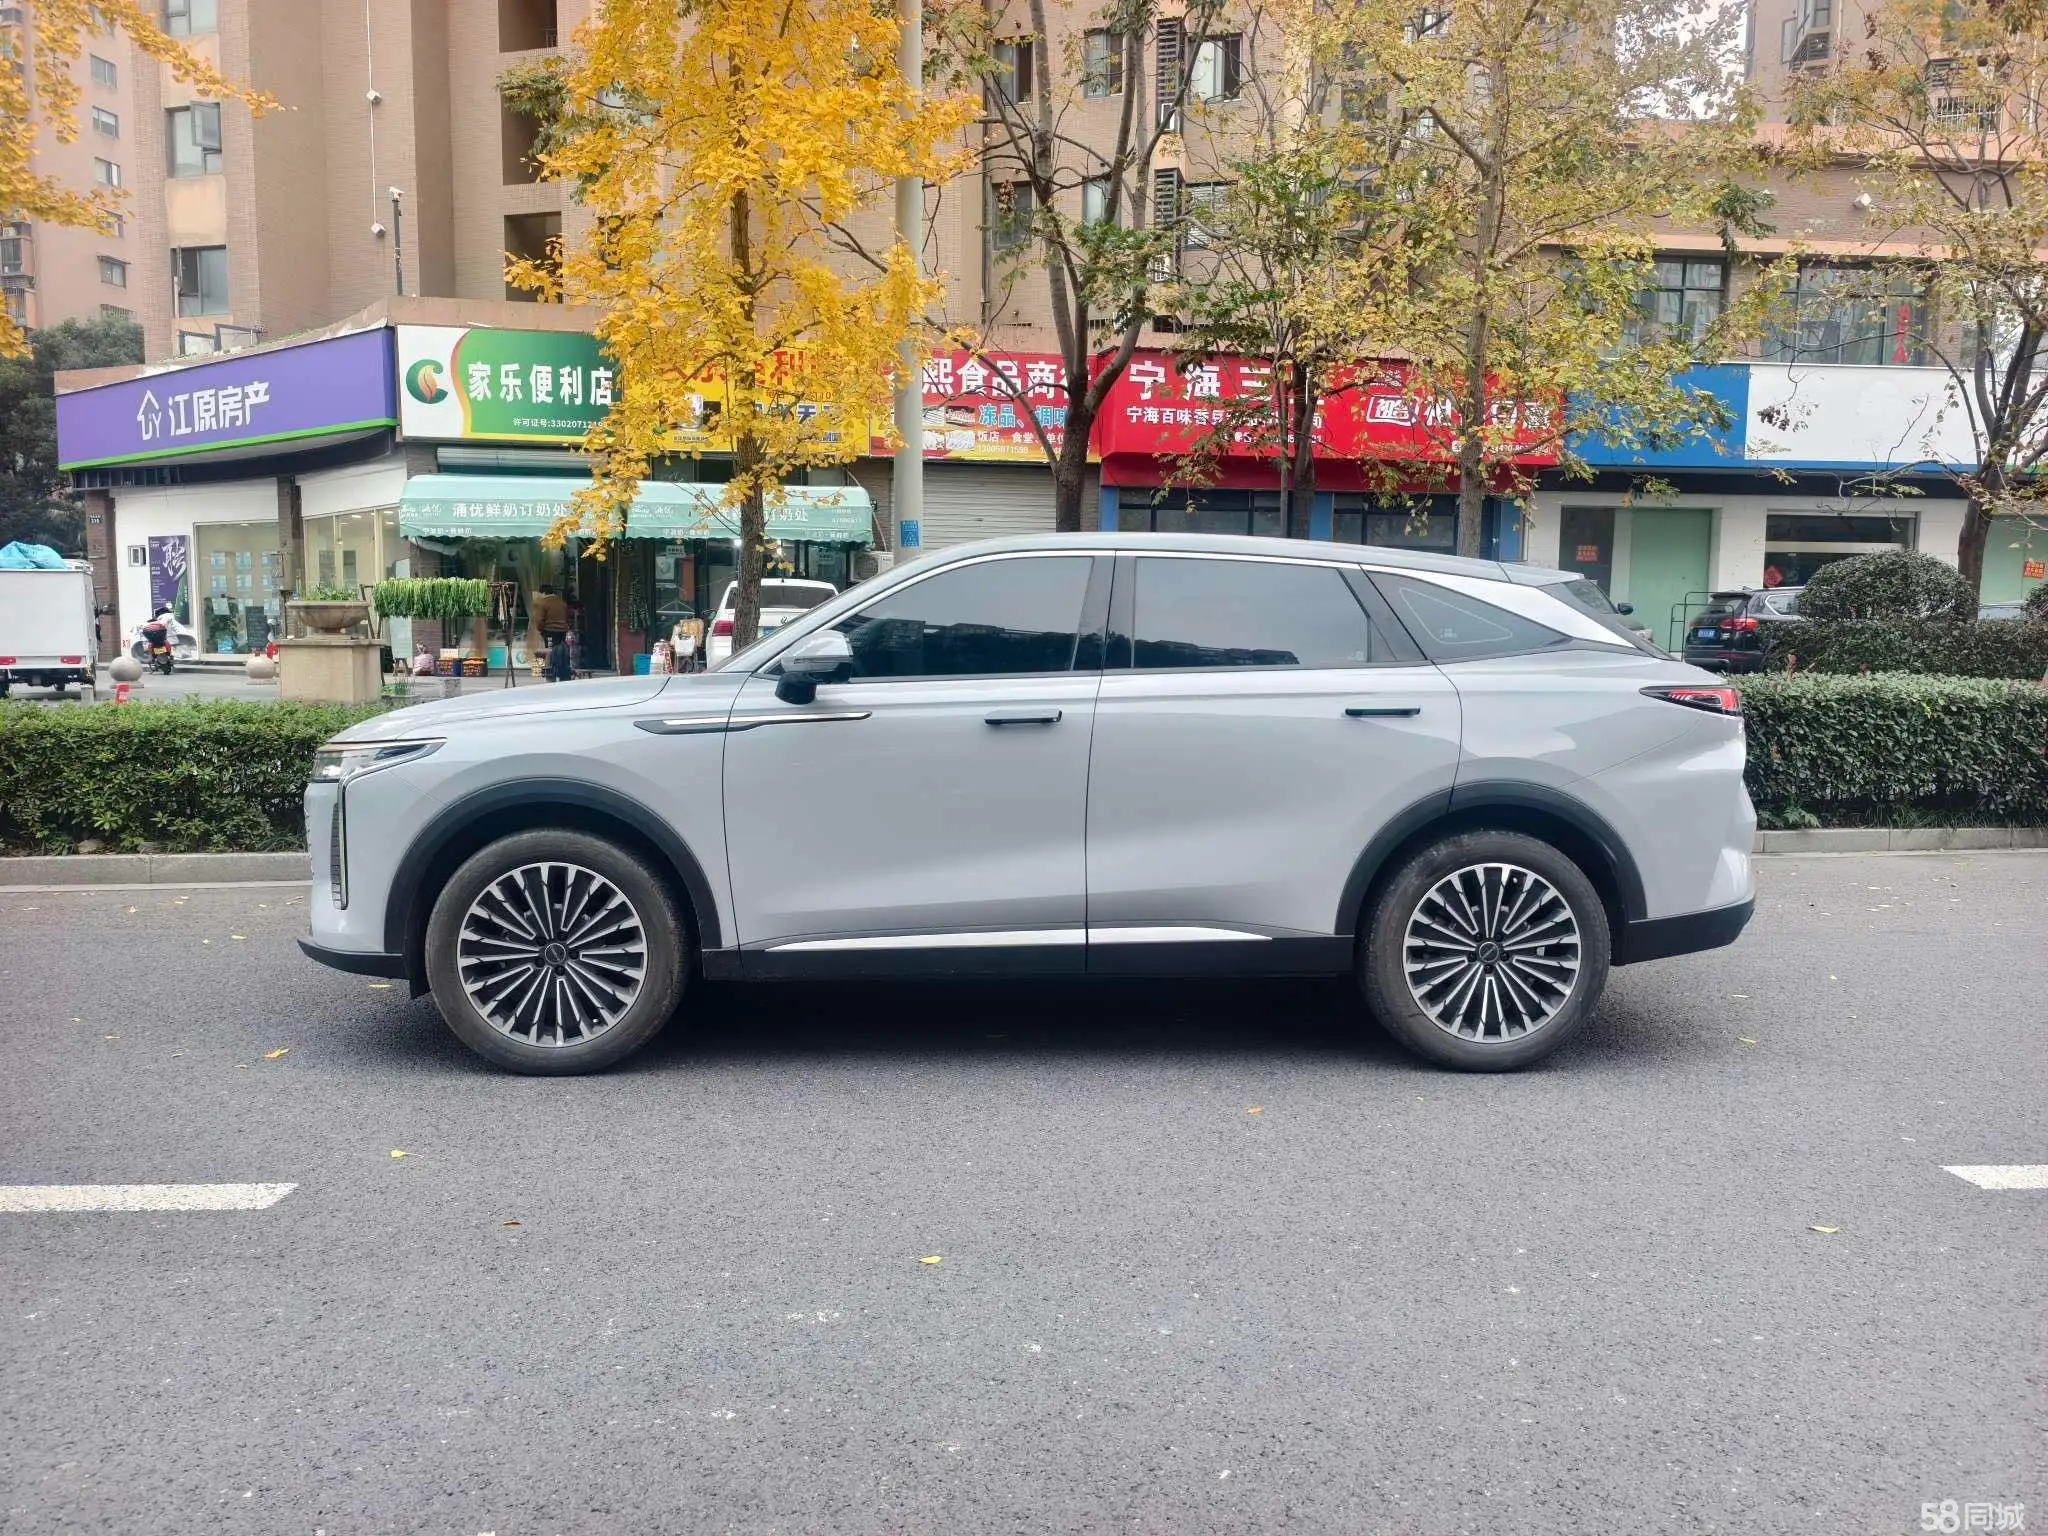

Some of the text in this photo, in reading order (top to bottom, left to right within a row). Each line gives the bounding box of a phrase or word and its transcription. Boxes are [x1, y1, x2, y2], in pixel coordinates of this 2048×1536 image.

[467, 361, 614, 406] 家乐便利店
[168, 381, 270, 437] 江原房产
